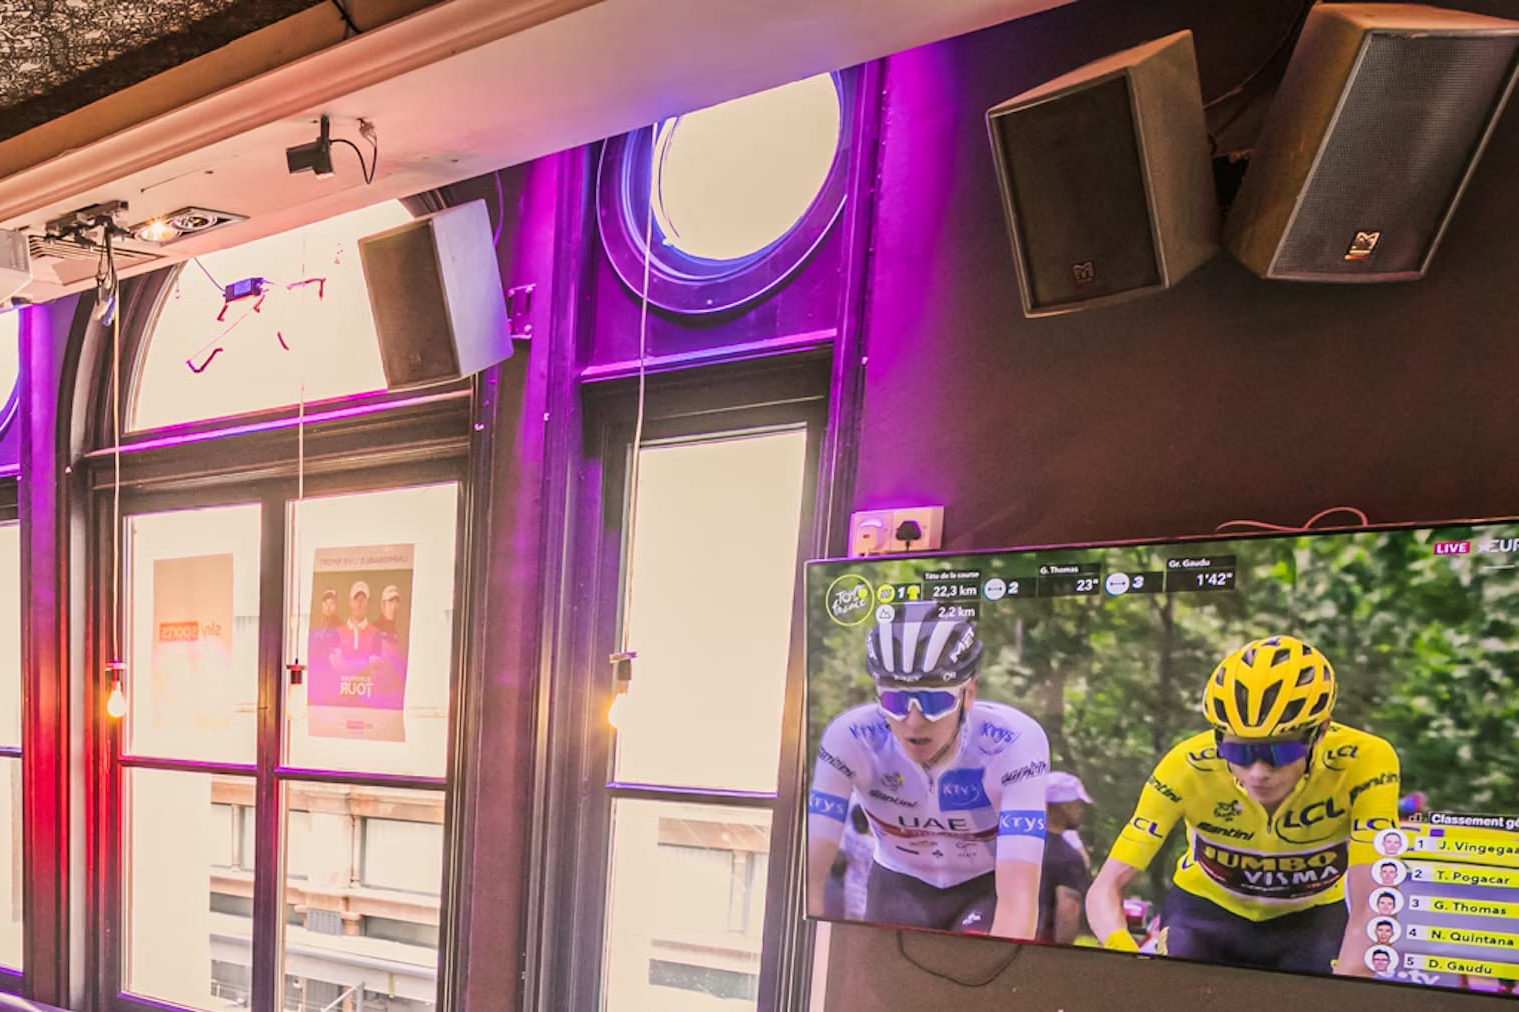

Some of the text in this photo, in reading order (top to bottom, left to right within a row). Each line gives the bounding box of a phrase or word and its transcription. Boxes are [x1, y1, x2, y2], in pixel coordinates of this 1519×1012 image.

[1436, 542, 1467, 554] LIVE
[1050, 565, 1079, 574] Thomas
[1182, 558, 1211, 568] Gaudu
[1008, 581, 1019, 594] 2
[1133, 575, 1144, 588] 3
[897, 586, 906, 599] 1
[932, 585, 977, 598] 22,3 km
[938, 605, 976, 618] 2,2 km
[981, 720, 1015, 744] Krys
[1327, 745, 1358, 760] LCL
[943, 783, 979, 796] Krys
[1283, 797, 1346, 829] LCL
[1431, 813, 1505, 827] Classement
[898, 815, 970, 832] UAE
[999, 814, 1045, 834] Krys
[1129, 816, 1163, 838] CL
[1418, 840, 1424, 849] 1
[1204, 846, 1338, 872] JUMBO
[1244, 865, 1339, 886] VISMA
[1414, 869, 1423, 879] 2
[1453, 871, 1510, 886] Pogacar
[1411, 898, 1507, 915] 3 G. Thomas
[1409, 928, 1515, 946] 4 N. Quintana
[1407, 957, 1493, 975] 5 D. Gaudu
